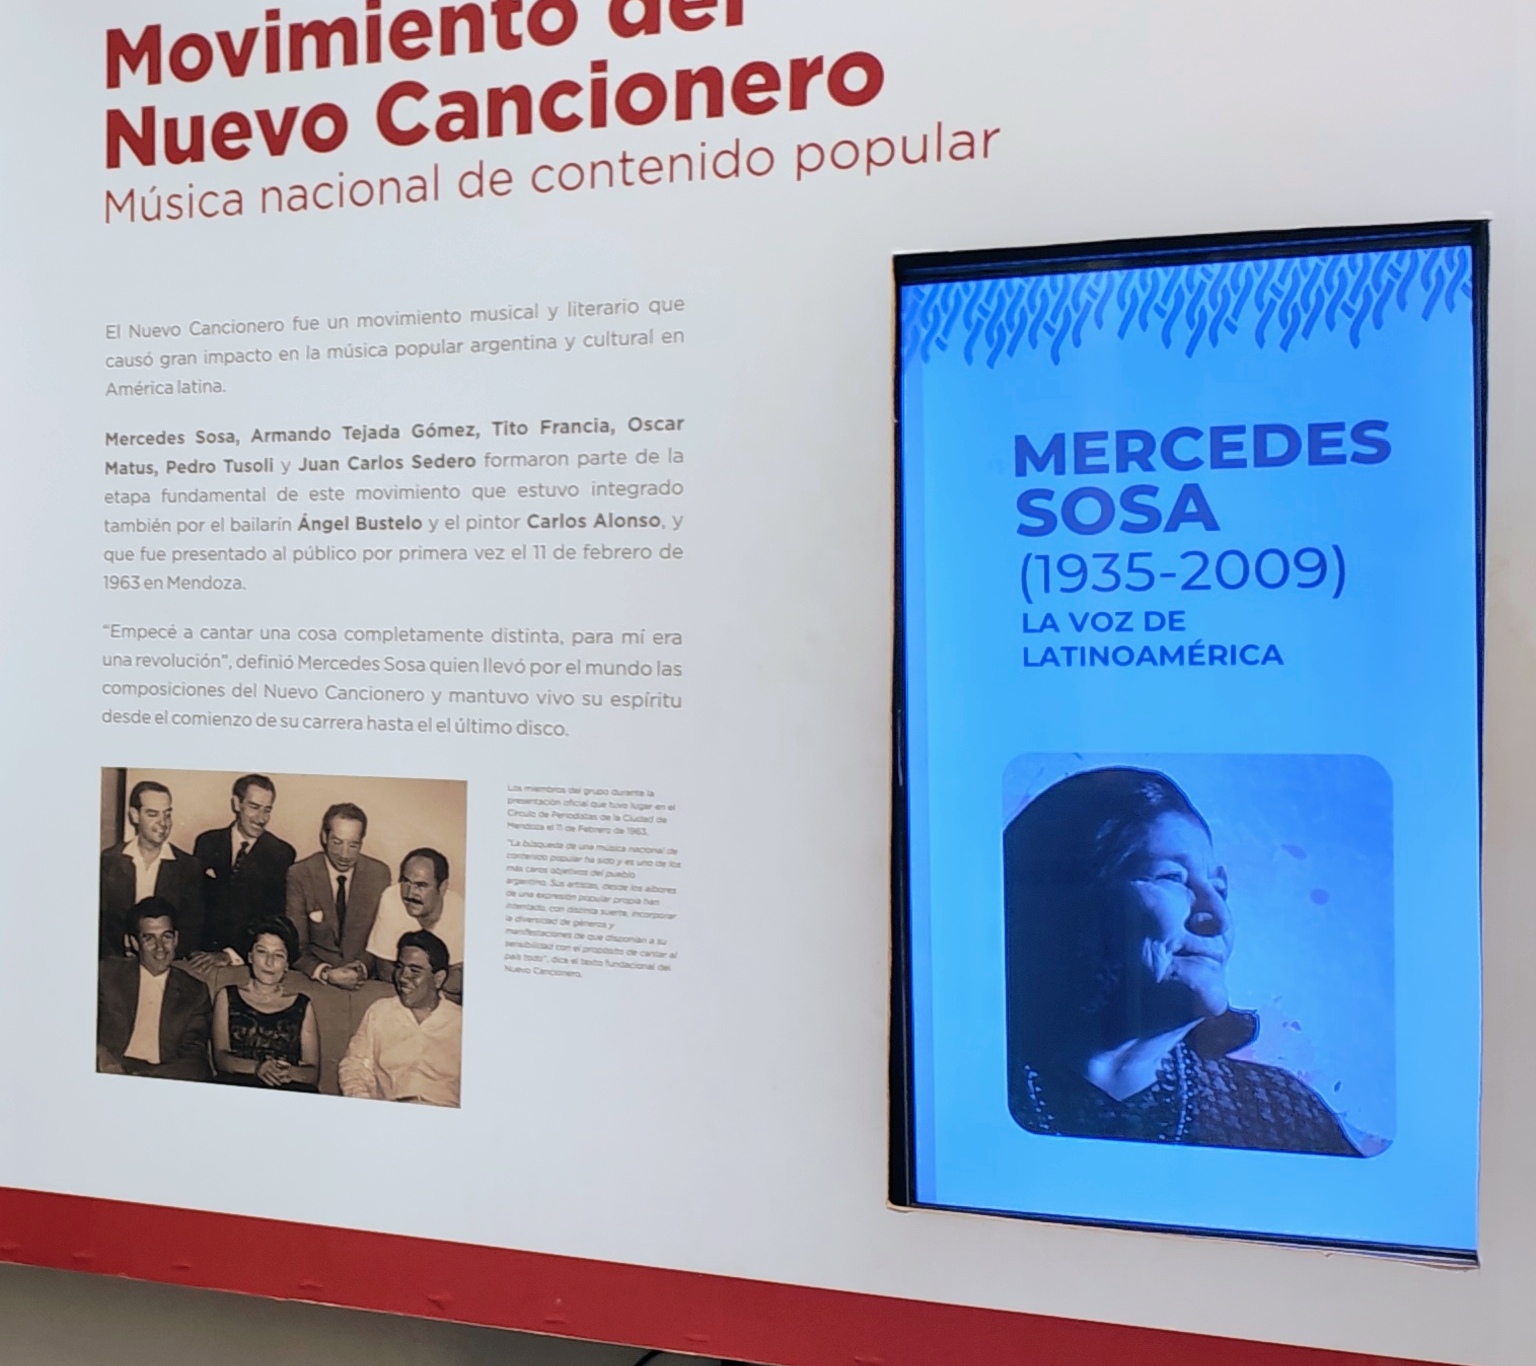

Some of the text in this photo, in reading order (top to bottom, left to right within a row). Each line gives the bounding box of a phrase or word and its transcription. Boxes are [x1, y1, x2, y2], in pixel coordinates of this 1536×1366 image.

[105, 50, 885, 169] Nuevo Cancionero
[104, 122, 1001, 224] Música nacional de contenido popular
[105, 298, 686, 340] El Nuevo Cancionero fue un movimiento musical y literario que
[104, 328, 685, 370] causó gran impacto en la música popular argentina y cultural en
[104, 378, 227, 398] América latina.
[104, 416, 686, 448] Mercedes Sosa, Armando Tejada Gómez, Tito Francia, Oscar
[104, 446, 685, 478] Matus, Pedro Tusoli y Juan Carlos Sedero formaron parte de la
[1014, 420, 1392, 477] MERCEDES
[103, 478, 685, 508] etapa fundamental de este movimiento que estuvo integrado
[103, 511, 685, 536] también por el bailarín Ángel Bustelo y el pintor Carlos Alonso, y
[1016, 483, 1221, 537] SOSA
[103, 542, 685, 565] que fue presentado al público por primera vez el 11 de febrero de
[102, 574, 247, 591] 1963 en Mendoza.
[1021, 544, 1346, 604] (1935-2009)
[183, 627, 195, 640] a
[199, 624, 255, 641] cantar
[259, 628, 291, 641] una
[297, 628, 338, 642] cosa
[343, 625, 485, 646] completamente
[490, 626, 565, 646] distinta,
[571, 631, 615, 648] para
[621, 628, 647, 646] mí
[651, 632, 683, 646] era
[1022, 610, 1186, 633] LA VOZ DE
[101, 654, 133, 668] una
[235, 652, 295, 670] definió
[297, 654, 381, 672] Mercedes
[382, 656, 427, 673] Sosa
[429, 656, 481, 676] quien
[482, 656, 527, 675] llevó
[529, 661, 563, 678] por
[565, 658, 583, 676] el
[585, 658, 653, 677] mundo
[655, 659, 683, 678] las
[1023, 639, 1284, 668] LATINOAMÉRICA
[101, 680, 683, 711] composiciones del Nuevo Cancionero y mantuvo vivo su espíritu
[101, 708, 570, 738] desde el comienzo de su carrera hasta el el último disco.
